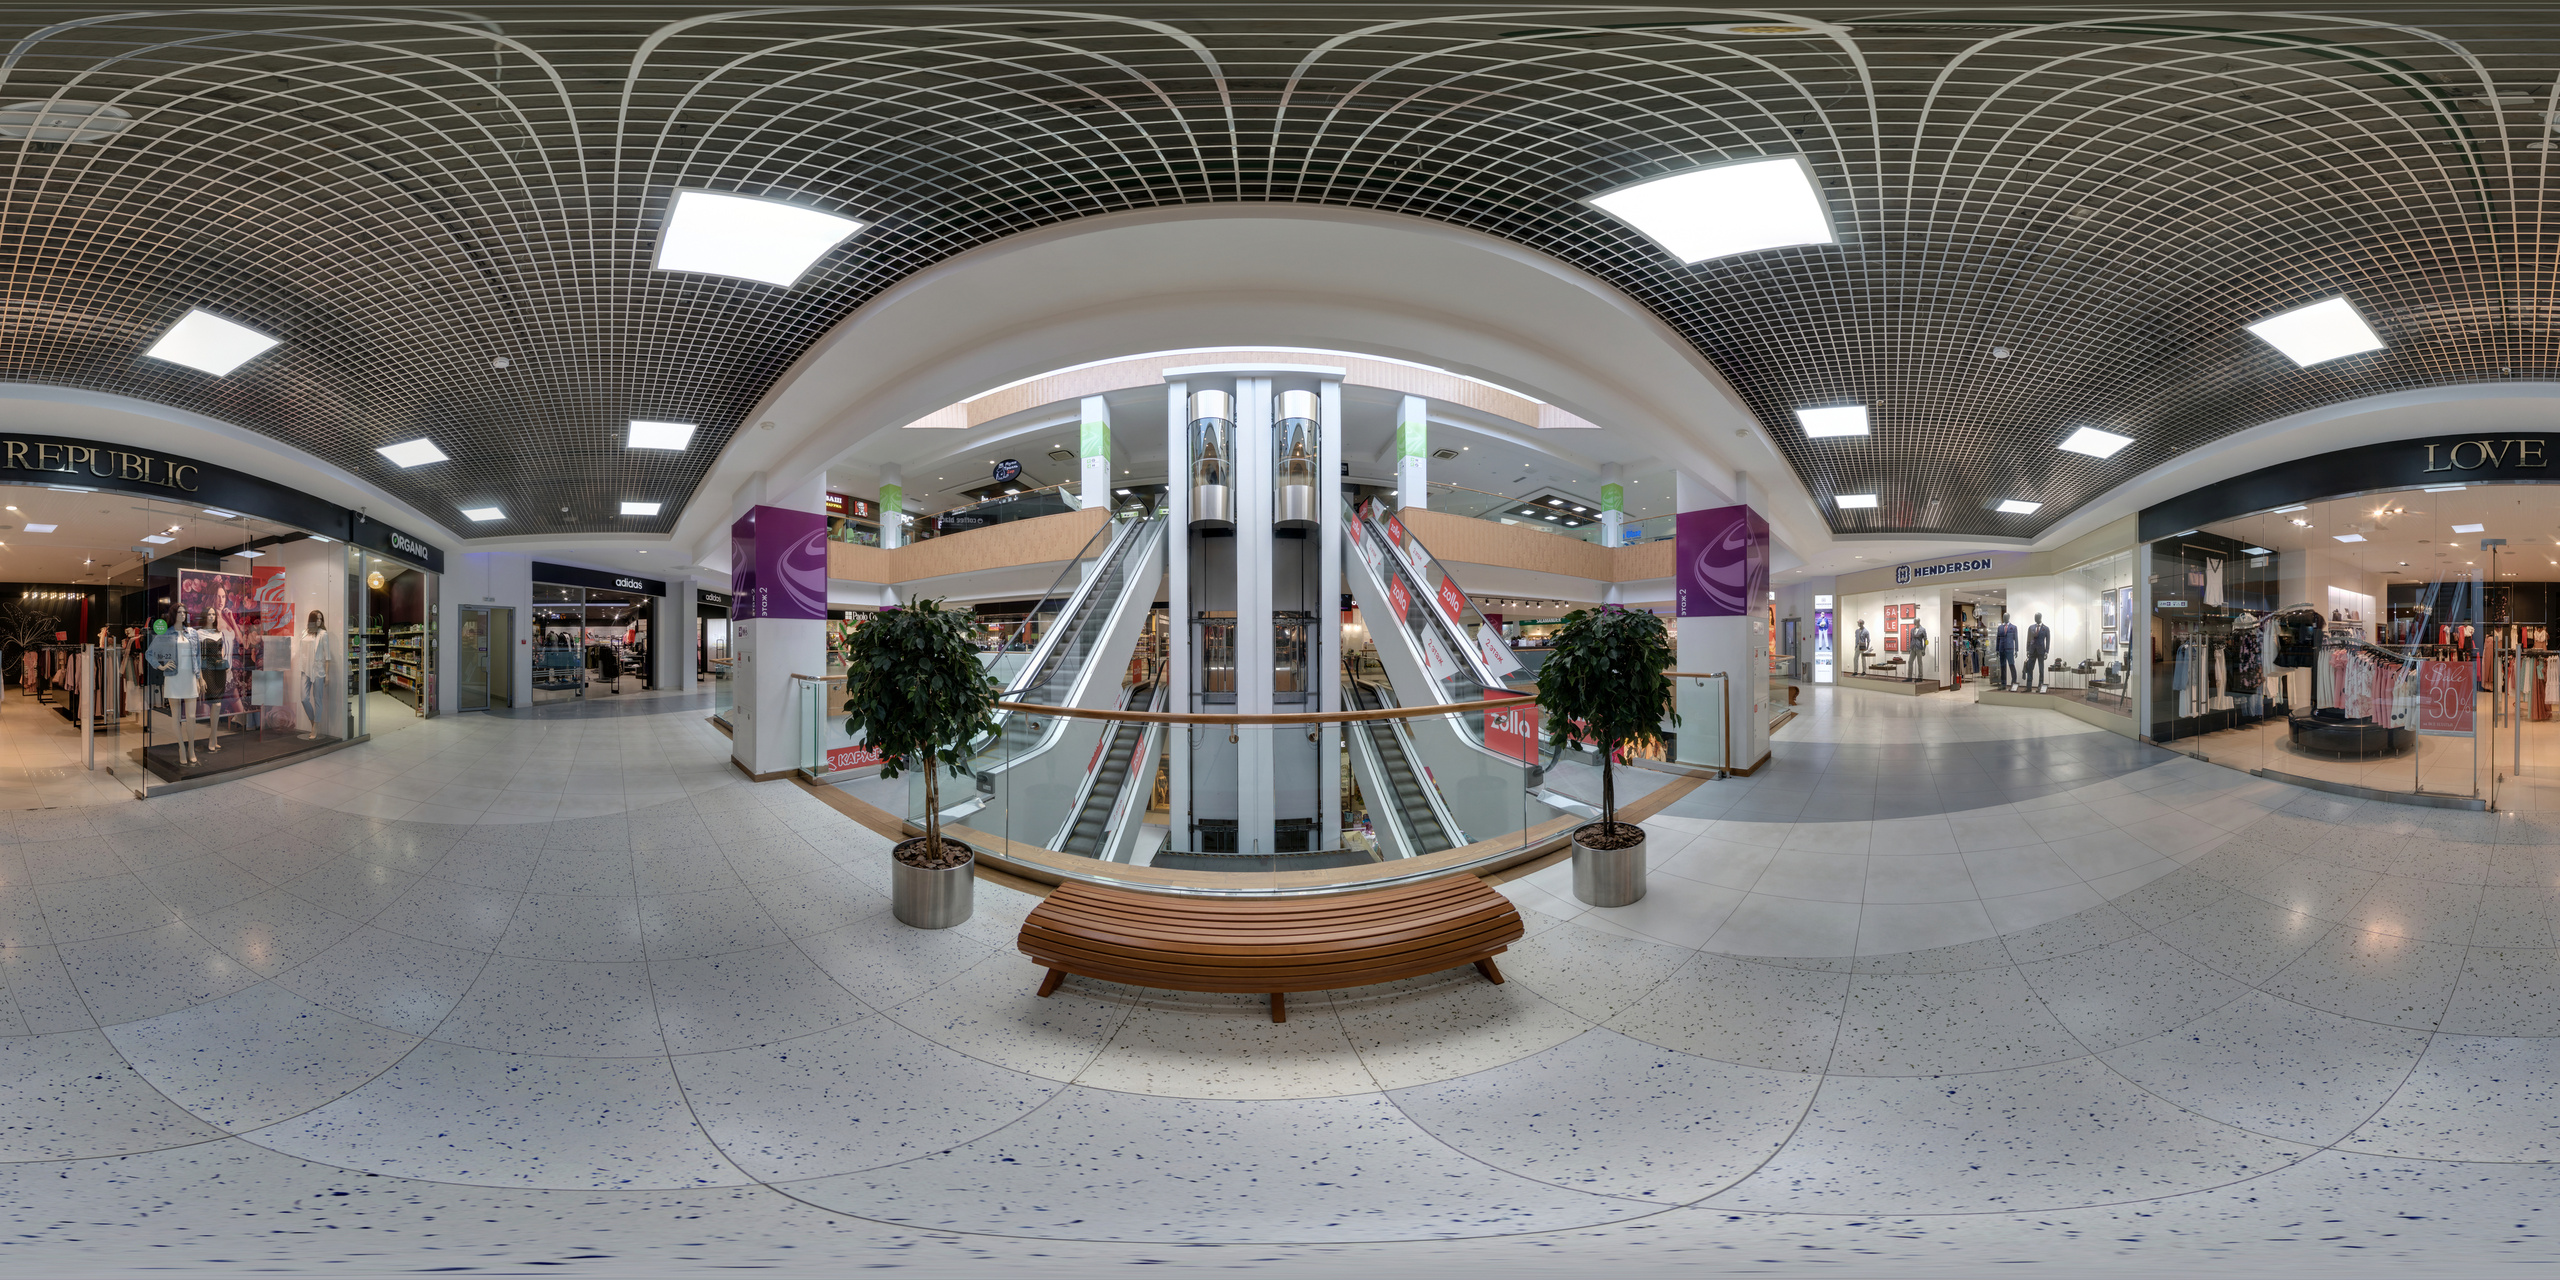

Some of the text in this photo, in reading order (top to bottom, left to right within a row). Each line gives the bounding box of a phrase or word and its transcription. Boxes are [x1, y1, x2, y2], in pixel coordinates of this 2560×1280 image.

[2, 441, 199, 492] REPUBLIC
[2423, 440, 2548, 473] LOVE
[1390, 523, 1400, 539] zolla
[391, 533, 428, 560] ORGANIQ
[1914, 559, 1992, 577] HENDERSON
[616, 578, 642, 589] adidas
[706, 594, 721, 602] adidas
[1392, 584, 1407, 611] zolla
[1442, 586, 1459, 613] zolla
[853, 611, 868, 620] Paolo
[1428, 638, 1443, 666] 2 этаж
[1485, 638, 1503, 664] 2 этаж
[2425, 663, 2467, 682] Sale
[1490, 711, 1530, 738] zolla
[838, 748, 882, 766] КАРУСЕ
